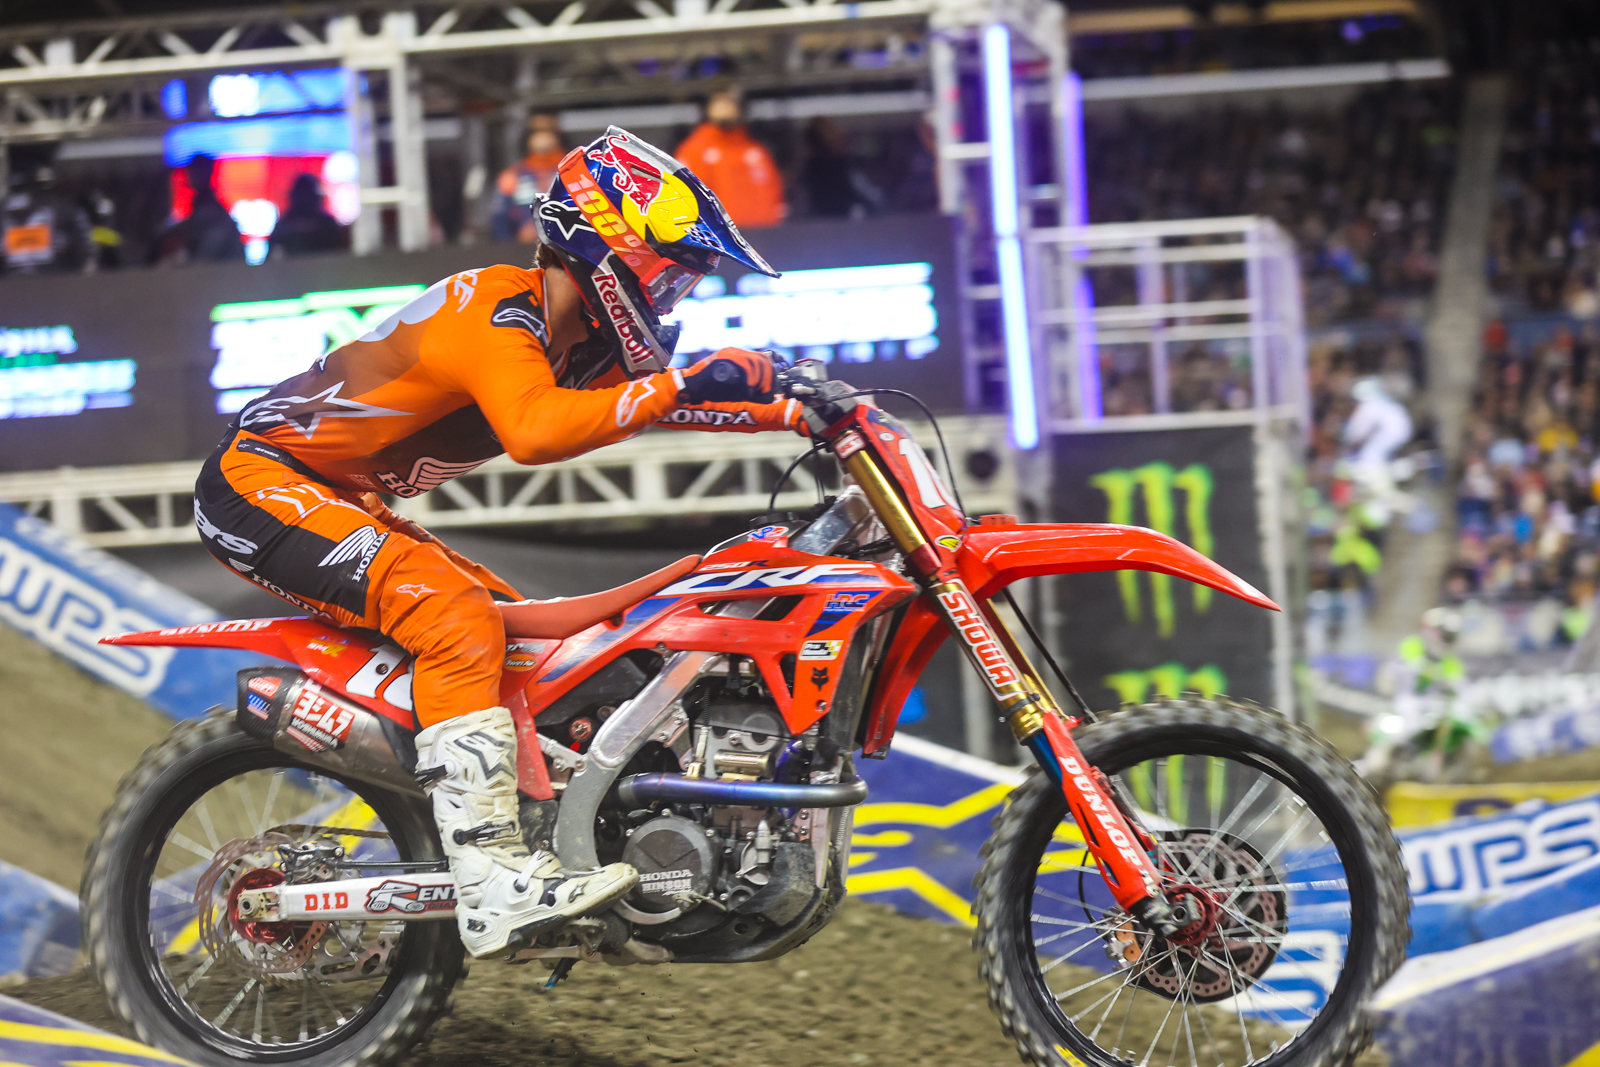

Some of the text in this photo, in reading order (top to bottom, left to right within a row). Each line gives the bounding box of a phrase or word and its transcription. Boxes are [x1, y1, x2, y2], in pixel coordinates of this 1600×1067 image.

[567, 173, 654, 268] 100%
[352, 531, 390, 583] HONDA
[655, 563, 877, 597] CRF
[252, 573, 334, 621] HONDA
[937, 589, 1020, 688] SHOWA
[1058, 755, 1144, 867] DUNLOP
[638, 868, 695, 883] HONDA
[304, 891, 349, 911] D.I.D
